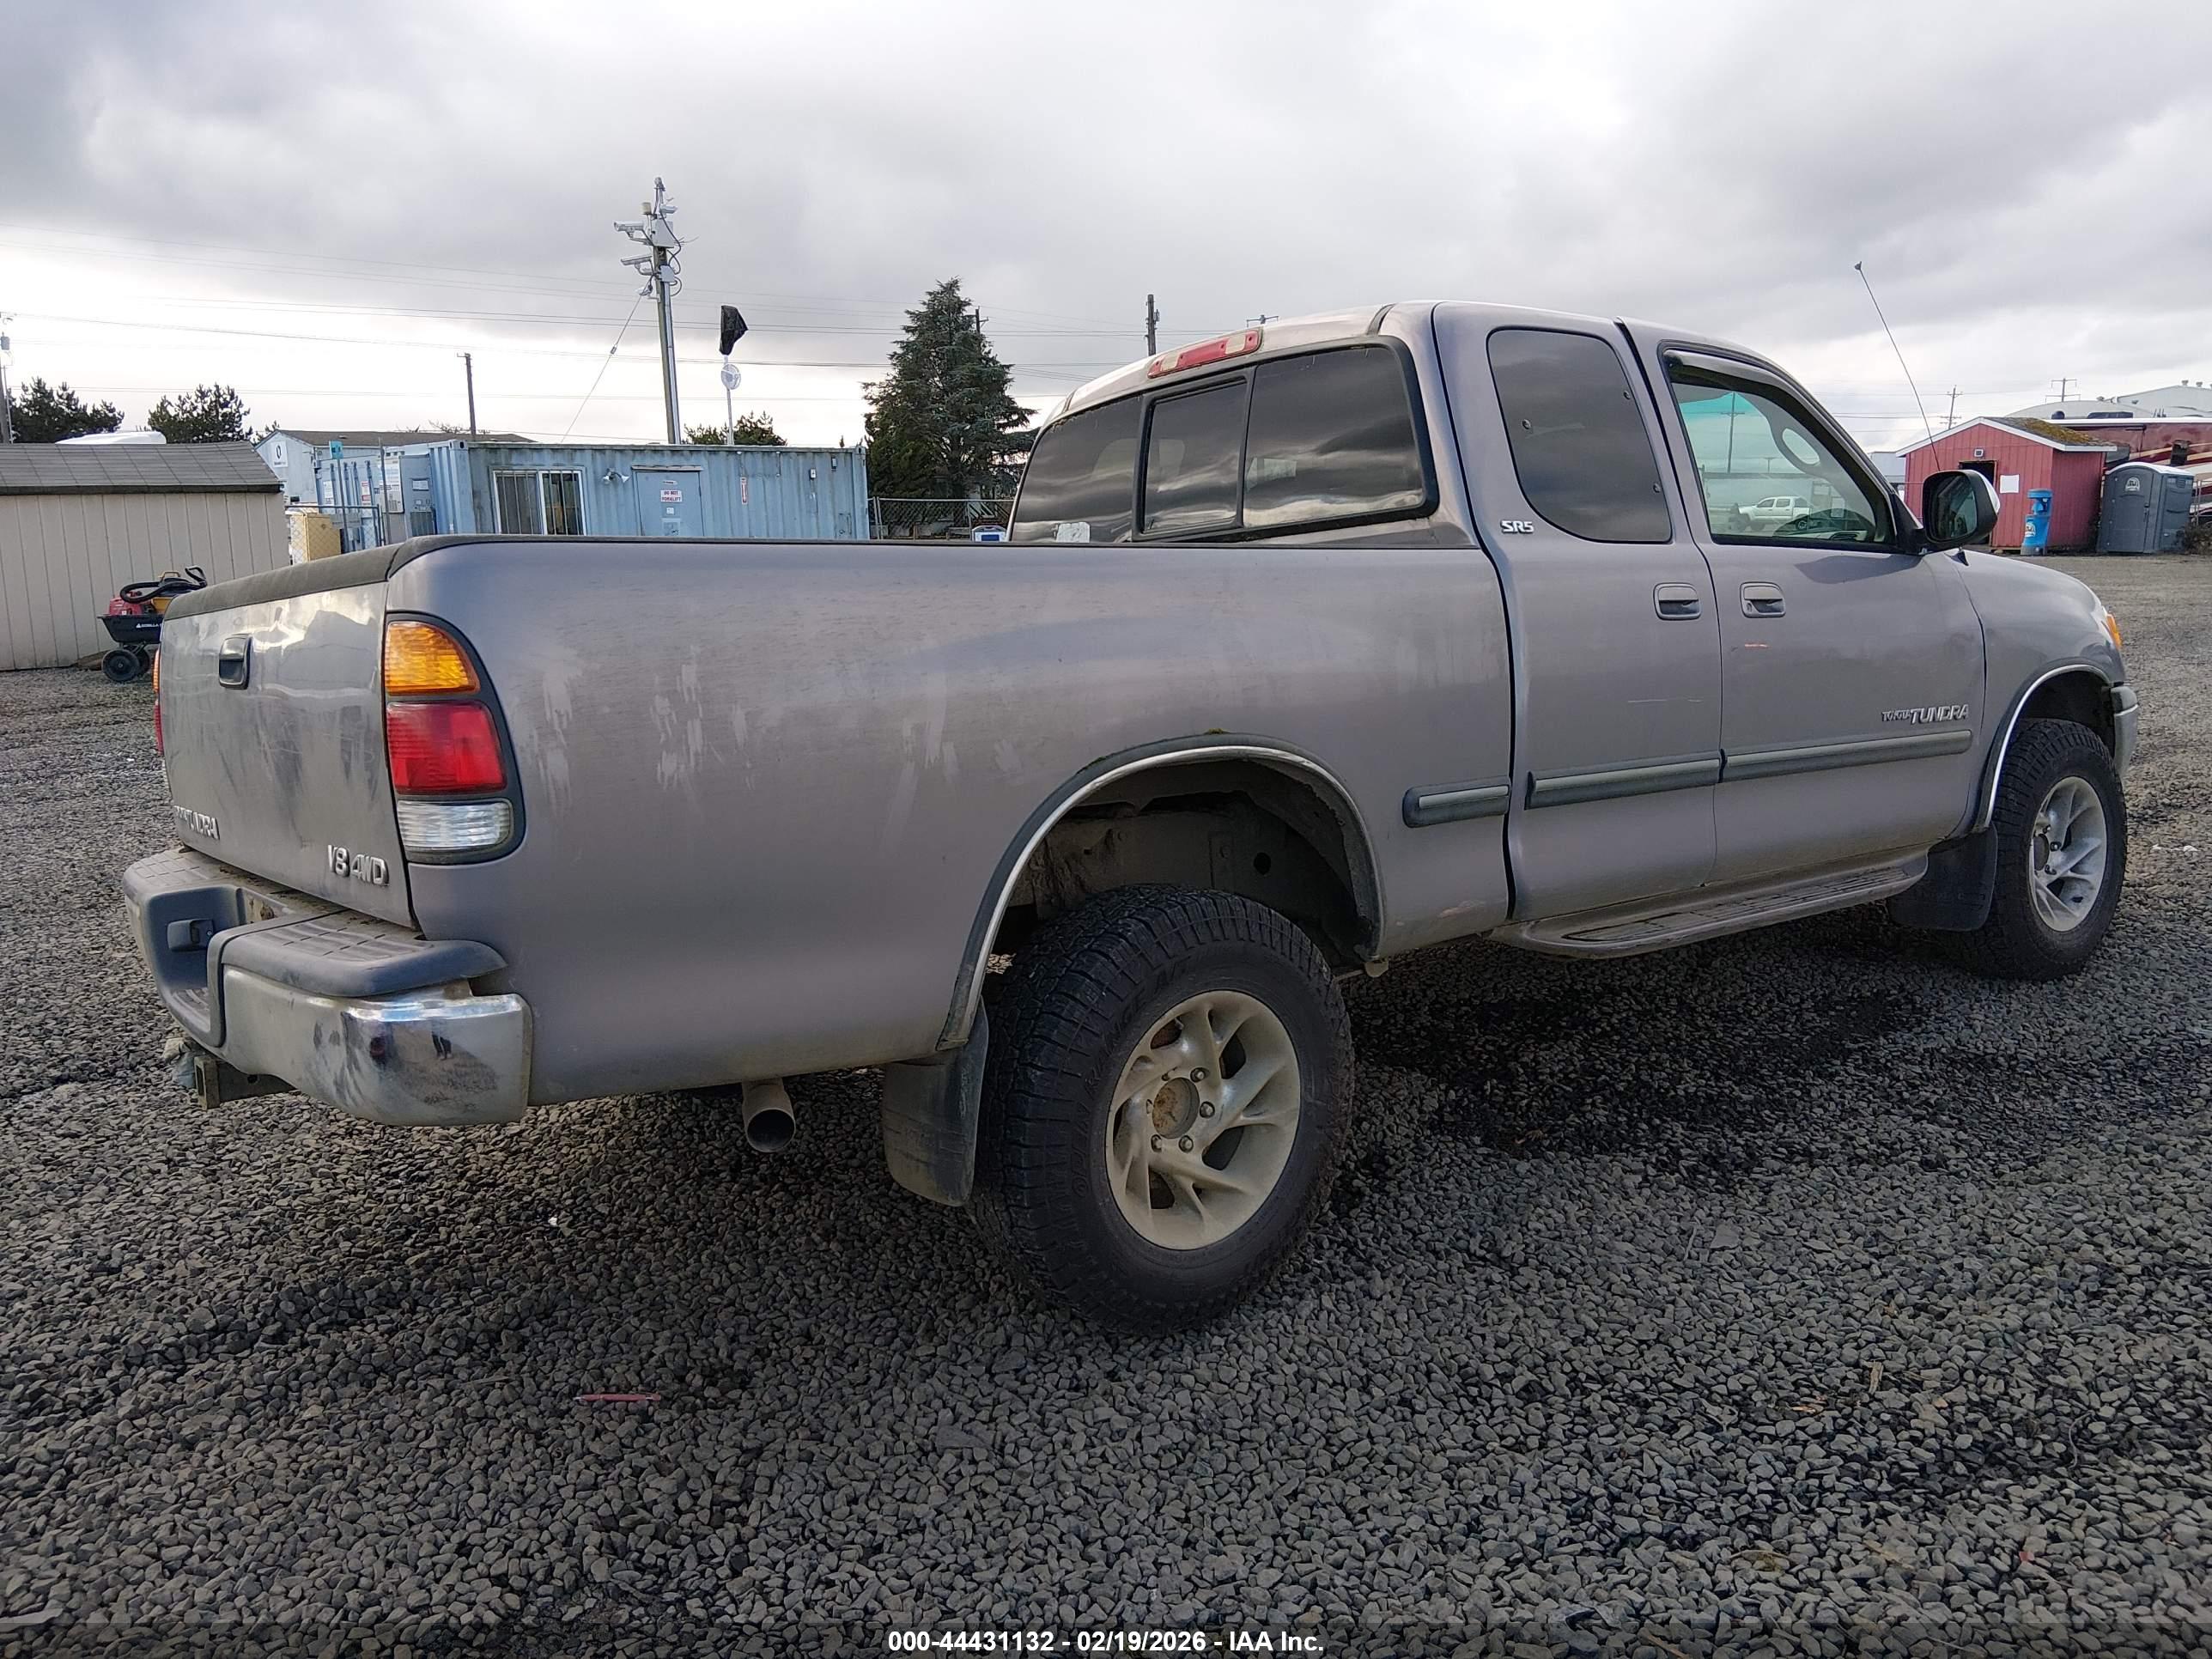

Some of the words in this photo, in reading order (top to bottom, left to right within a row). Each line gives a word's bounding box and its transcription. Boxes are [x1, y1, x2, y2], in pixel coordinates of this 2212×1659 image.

[1500, 520, 1534, 533] SR5
[1910, 704, 1969, 725] TUNDRA
[327, 844, 349, 877] V8
[350, 854, 389, 886] 4WD
